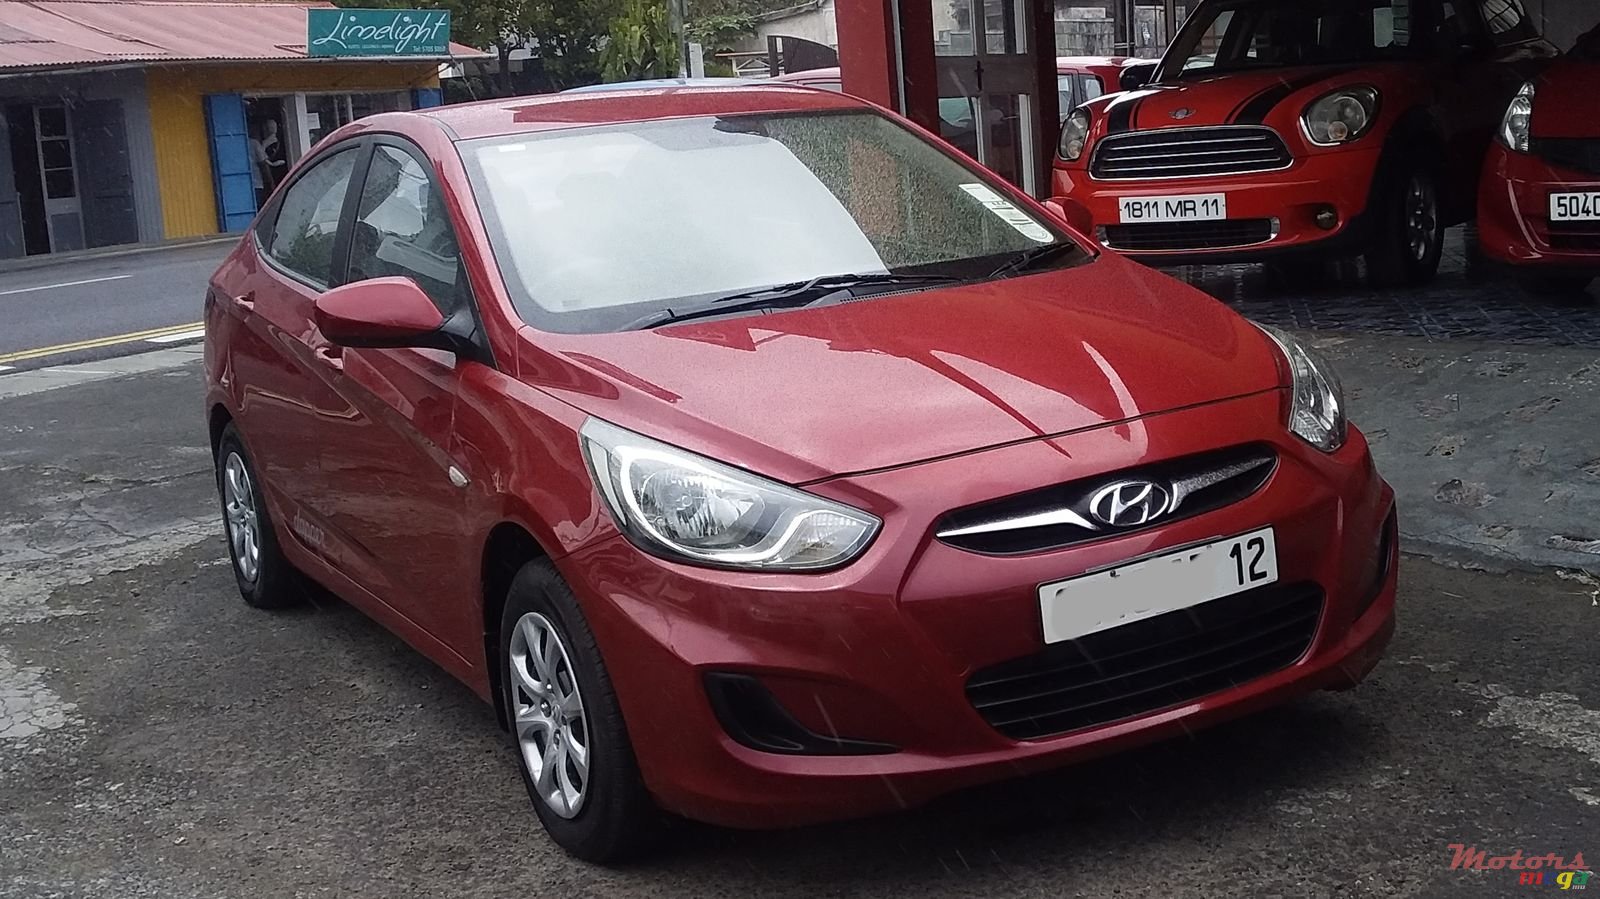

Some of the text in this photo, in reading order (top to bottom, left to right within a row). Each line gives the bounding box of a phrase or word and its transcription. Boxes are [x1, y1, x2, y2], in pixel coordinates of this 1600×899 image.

[312, 12, 447, 53] Limelight
[1124, 199, 1219, 218] 1811 MR 11
[1229, 536, 1267, 586] 12
